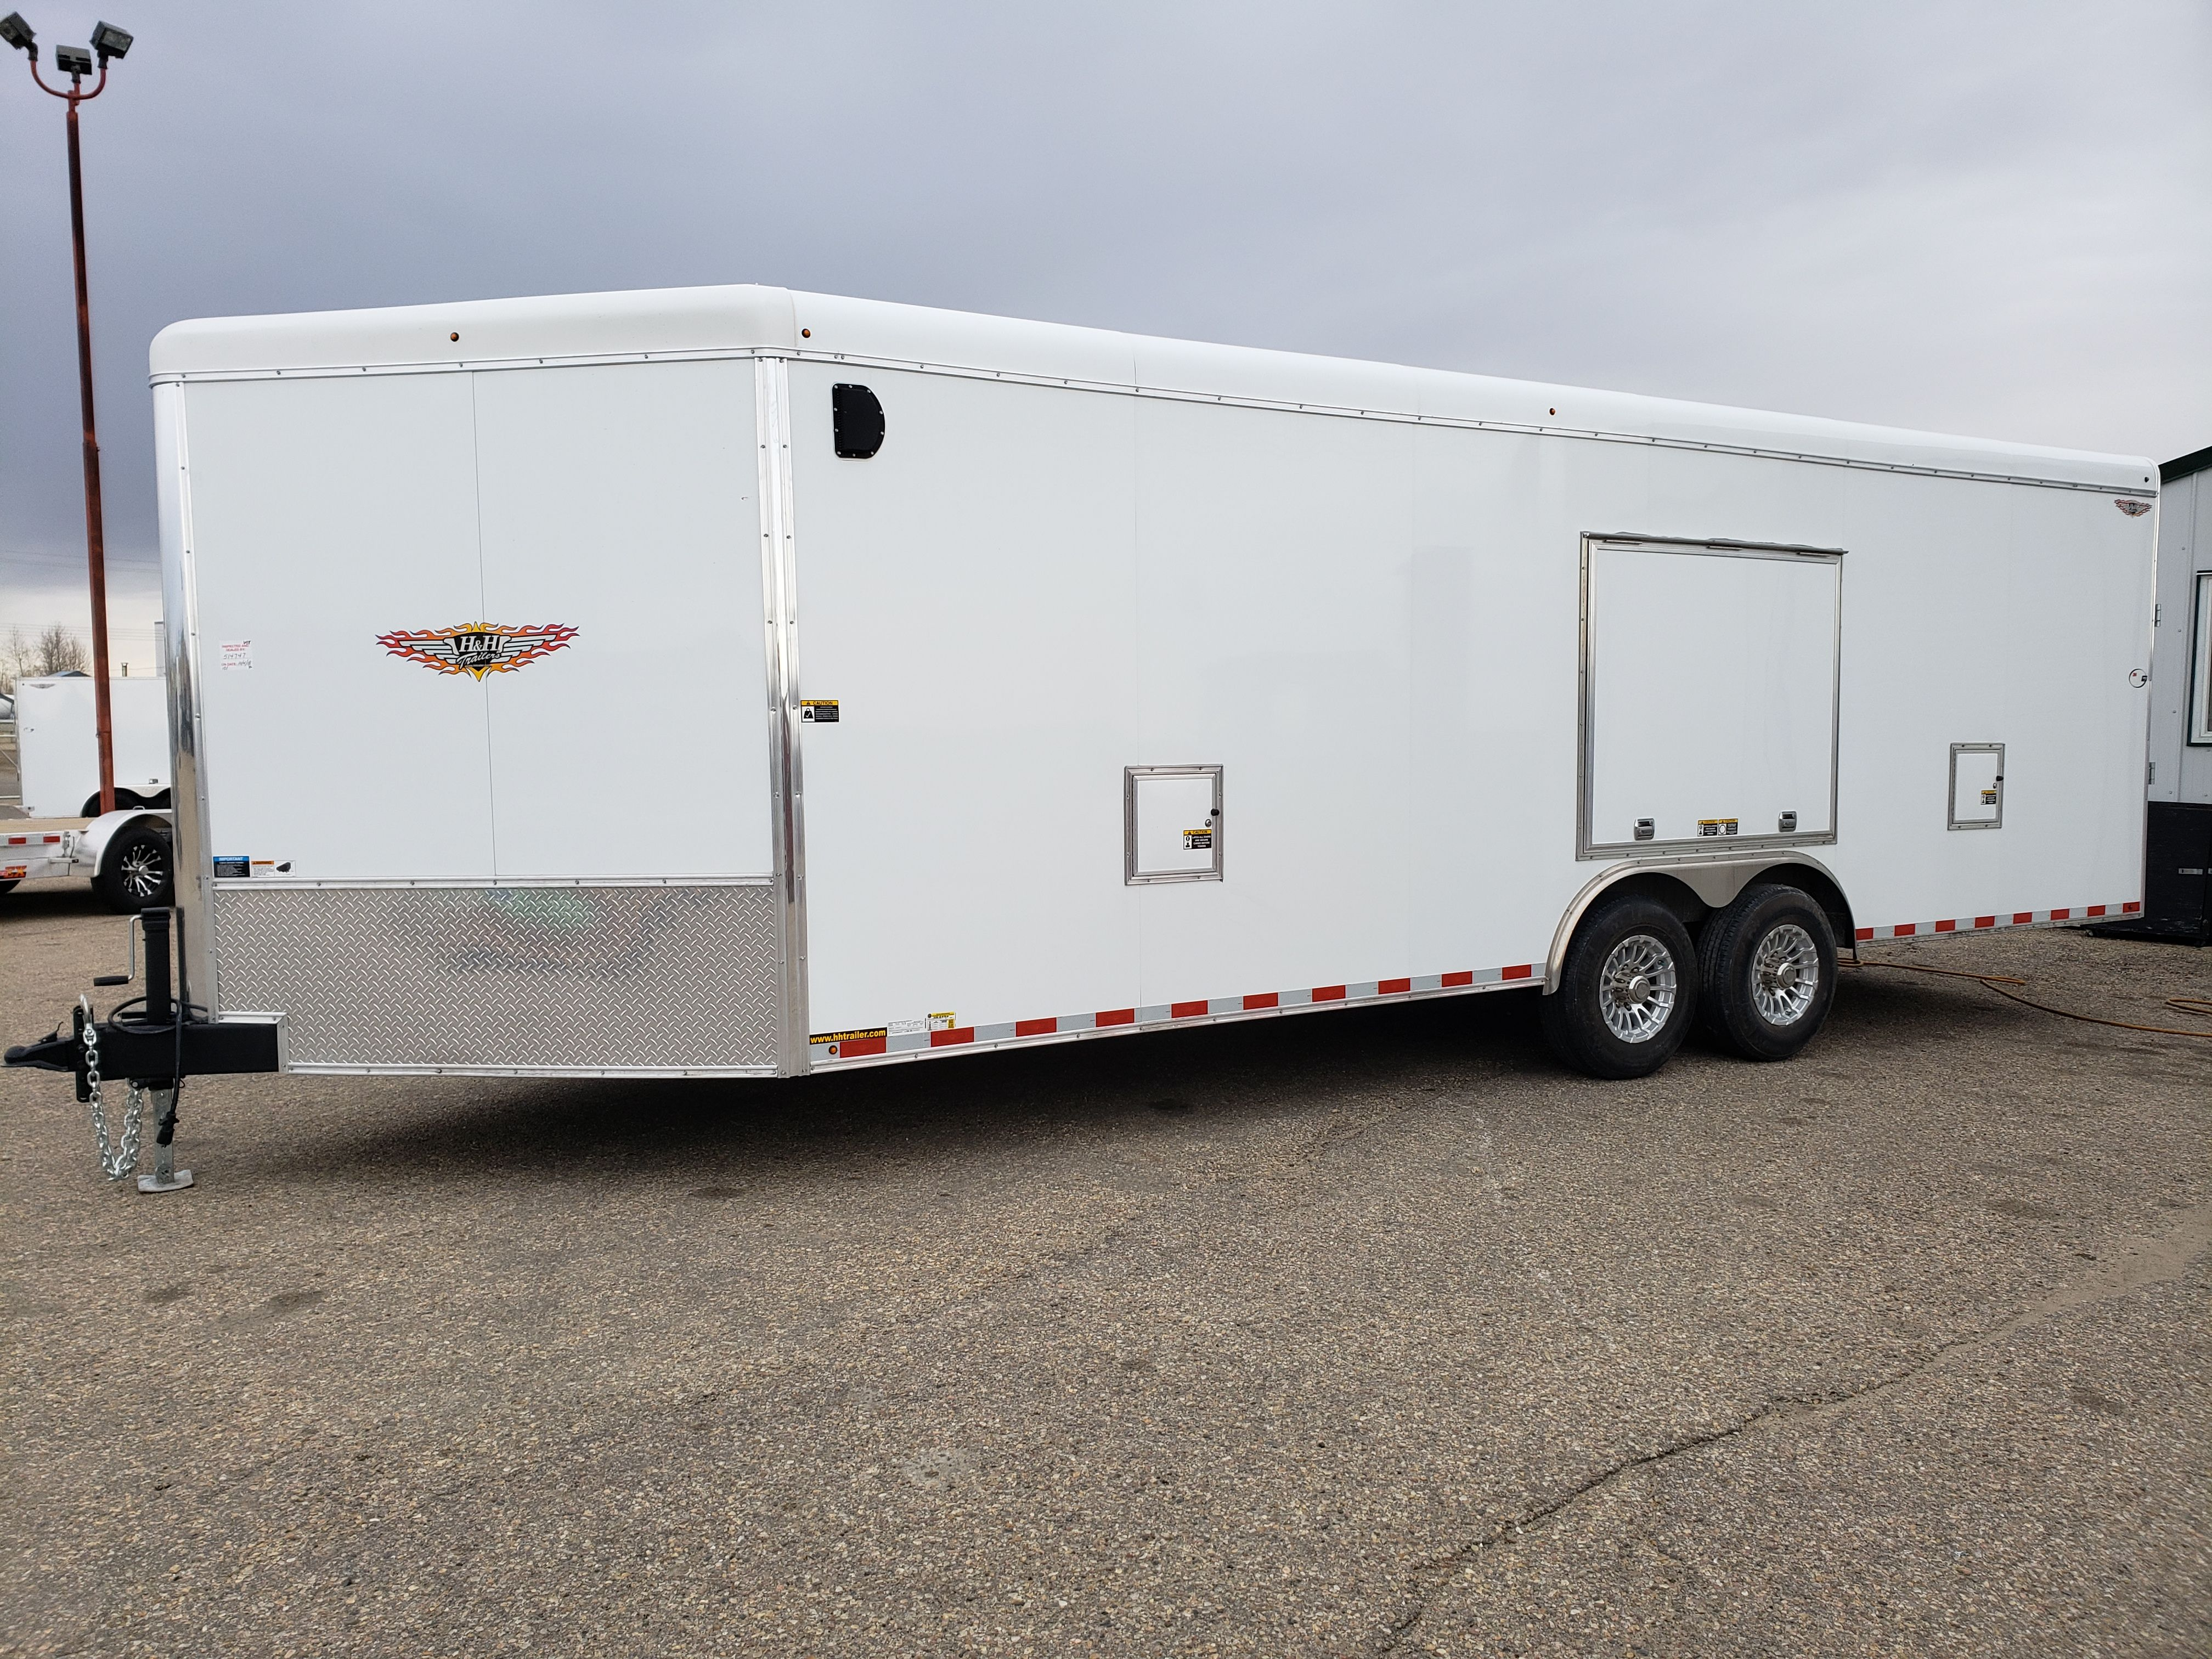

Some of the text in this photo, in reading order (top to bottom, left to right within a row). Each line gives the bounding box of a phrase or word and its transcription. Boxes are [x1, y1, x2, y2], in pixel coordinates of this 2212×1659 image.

[459, 635, 500, 652] H&H
[456, 651, 500, 669] Trailers
[810, 1030, 886, 1043] www.hhtrailer.com
